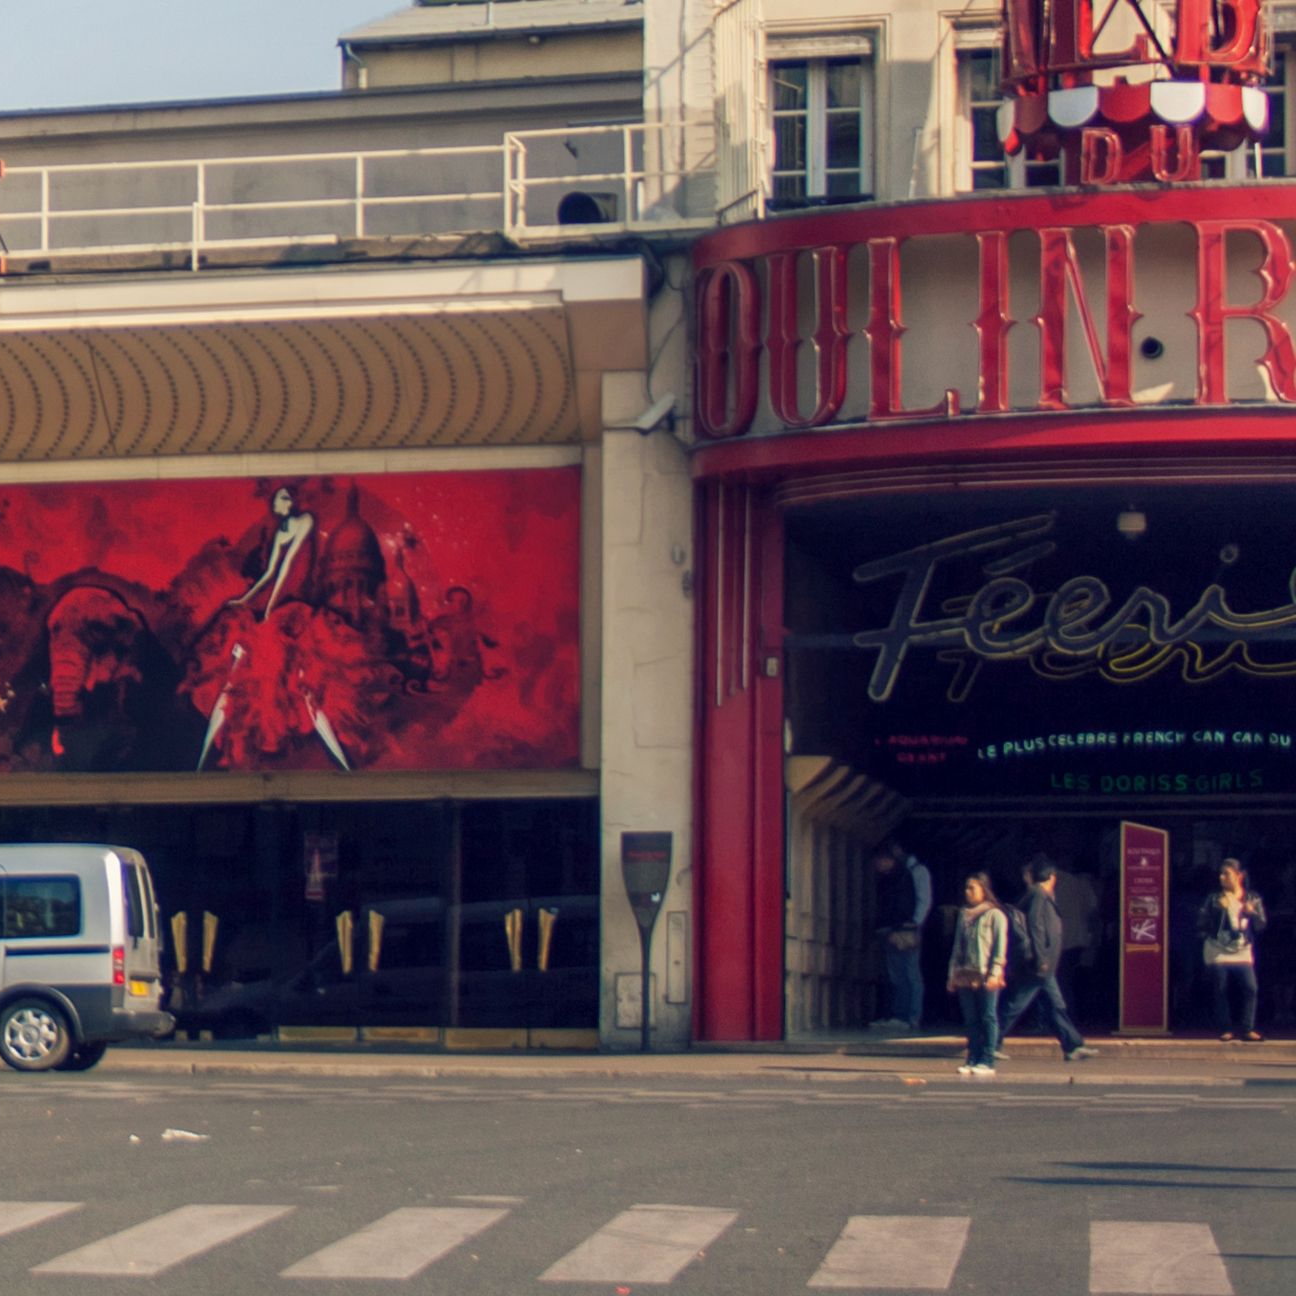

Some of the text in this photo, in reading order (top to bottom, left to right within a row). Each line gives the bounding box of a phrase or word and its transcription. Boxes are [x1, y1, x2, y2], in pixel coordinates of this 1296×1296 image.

[1080, 123, 1195, 184] DU
[977, 744, 997, 760] LE
[1003, 736, 1046, 755] PLUS
[1122, 730, 1186, 744] FRENCH
[1192, 730, 1226, 744] CAN
[1232, 731, 1263, 744] CAN
[1269, 732, 1292, 747] DU
[1051, 772, 1091, 791] LES
